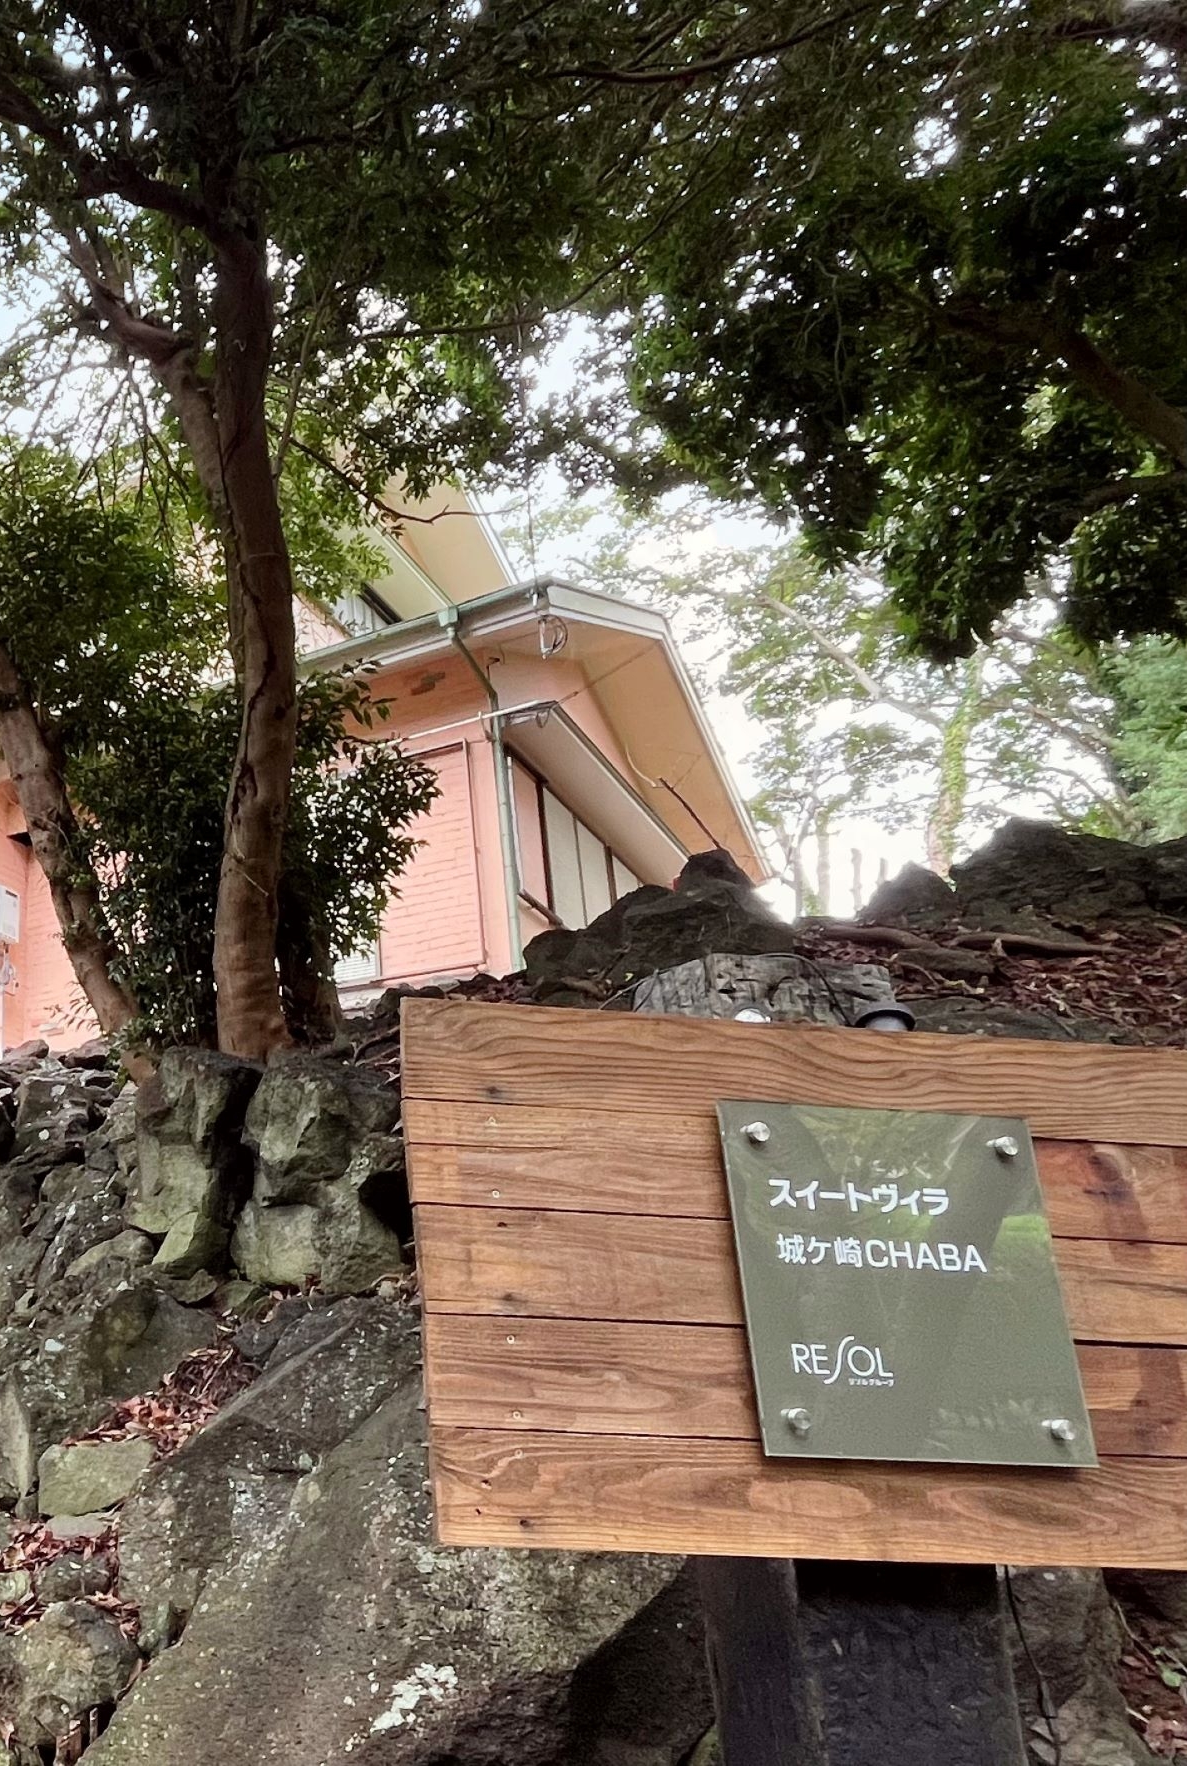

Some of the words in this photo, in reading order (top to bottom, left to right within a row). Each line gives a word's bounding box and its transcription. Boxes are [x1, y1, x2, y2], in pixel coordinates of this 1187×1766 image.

[768, 1178, 949, 1217] スイートヴィラ
[790, 1335, 894, 1385] RESOL
